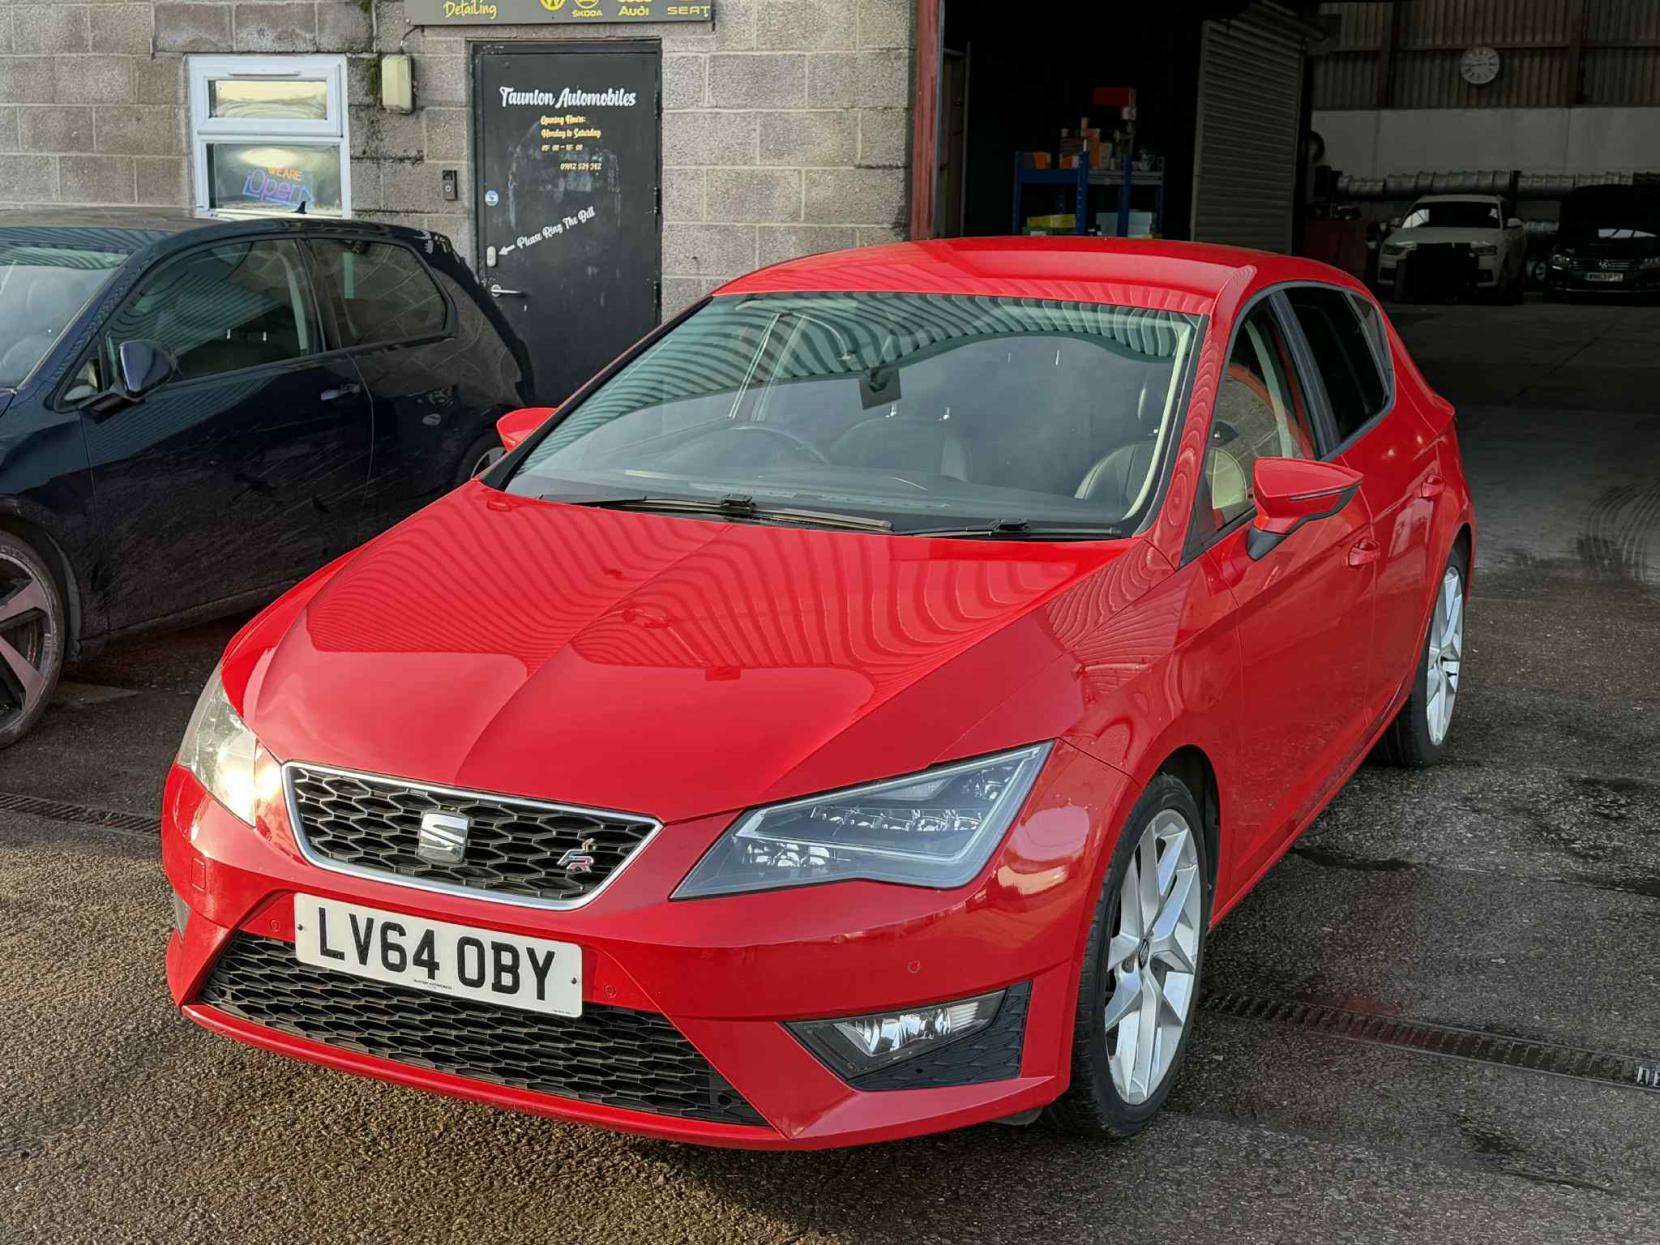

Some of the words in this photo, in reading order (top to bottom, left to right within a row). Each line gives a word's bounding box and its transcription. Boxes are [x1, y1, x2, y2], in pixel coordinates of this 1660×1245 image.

[443, 0, 497, 20] Detailing
[618, 6, 650, 17] Audi
[667, 5, 710, 16] SEAT
[499, 86, 555, 108] Taunton
[554, 87, 637, 109] Automobiles
[250, 168, 304, 206] Open
[516, 233, 542, 249] Please
[542, 223, 564, 239] Ring
[562, 216, 579, 229] The
[318, 906, 440, 980] LV64
[457, 936, 556, 1001] OBY
